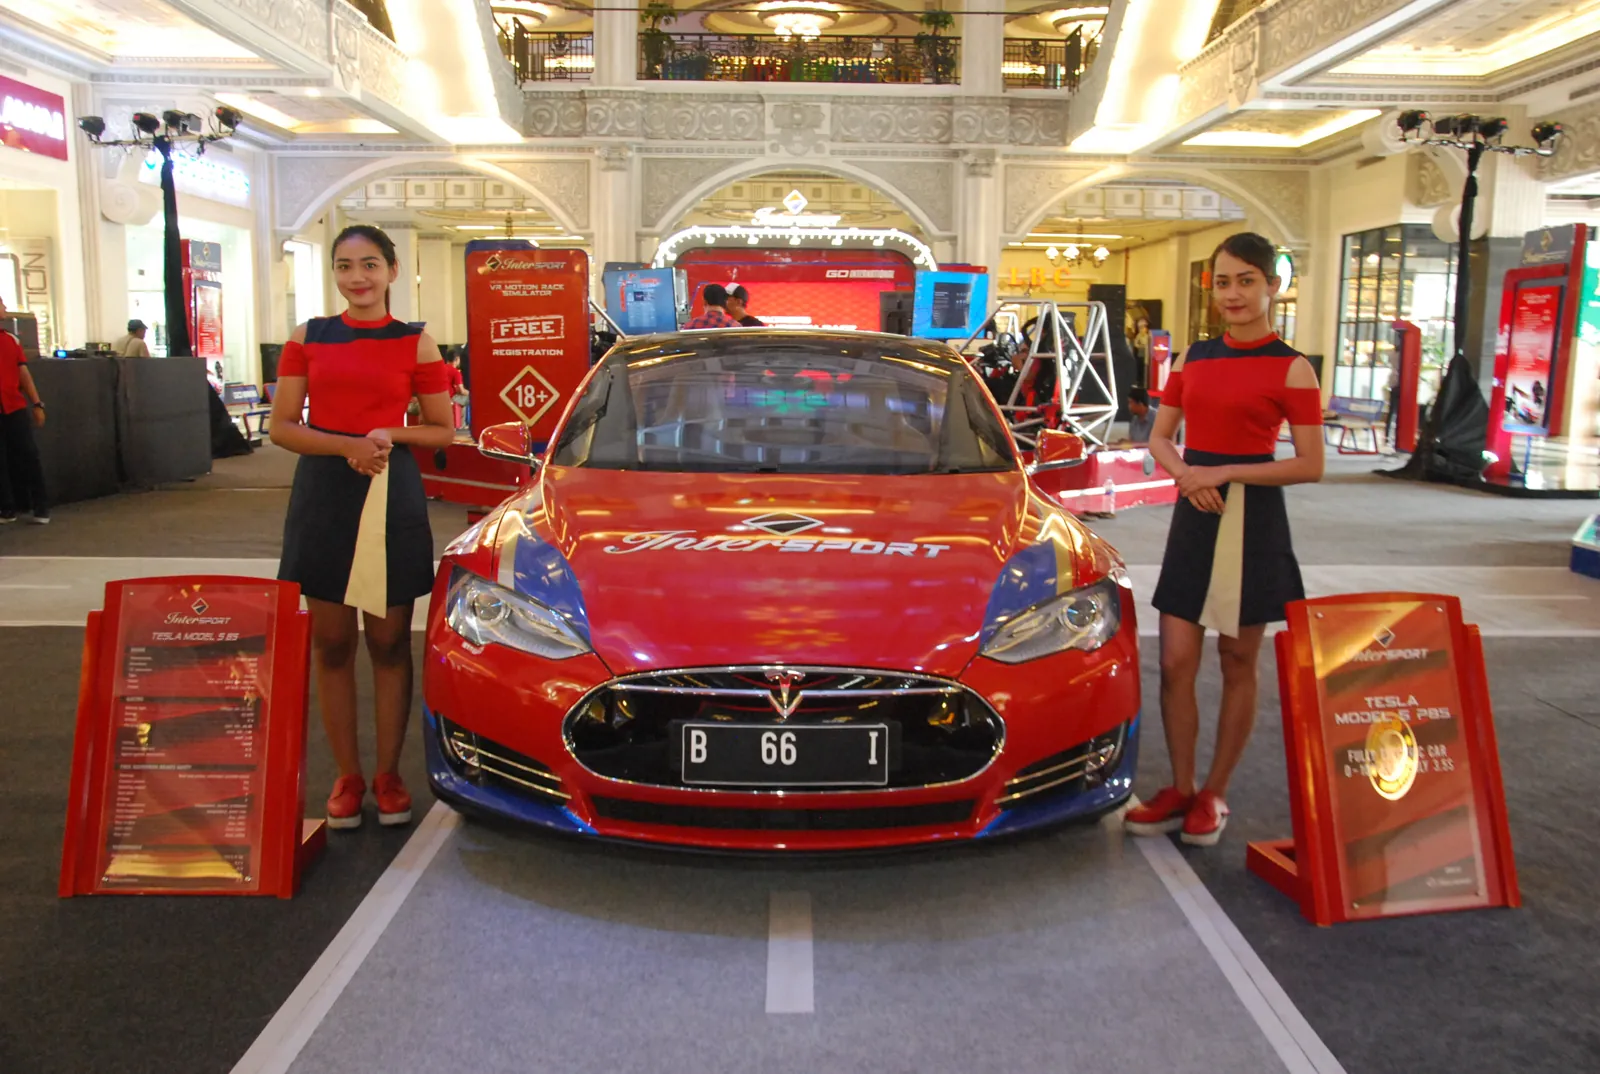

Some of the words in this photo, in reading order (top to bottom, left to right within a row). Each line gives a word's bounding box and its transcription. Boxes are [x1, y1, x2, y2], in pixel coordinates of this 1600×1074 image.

[500, 321, 555, 337] FREE
[492, 348, 564, 357] REGISTRATION
[515, 384, 549, 409] 18+
[152, 631, 182, 642] TESLA
[183, 632, 216, 642] MODEL
[1364, 694, 1419, 710] TESLA
[1334, 709, 1393, 726] MODEL
[690, 729, 708, 764] B
[760, 731, 798, 766] 66
[868, 731, 879, 765] I
[1427, 744, 1448, 758] CAR
